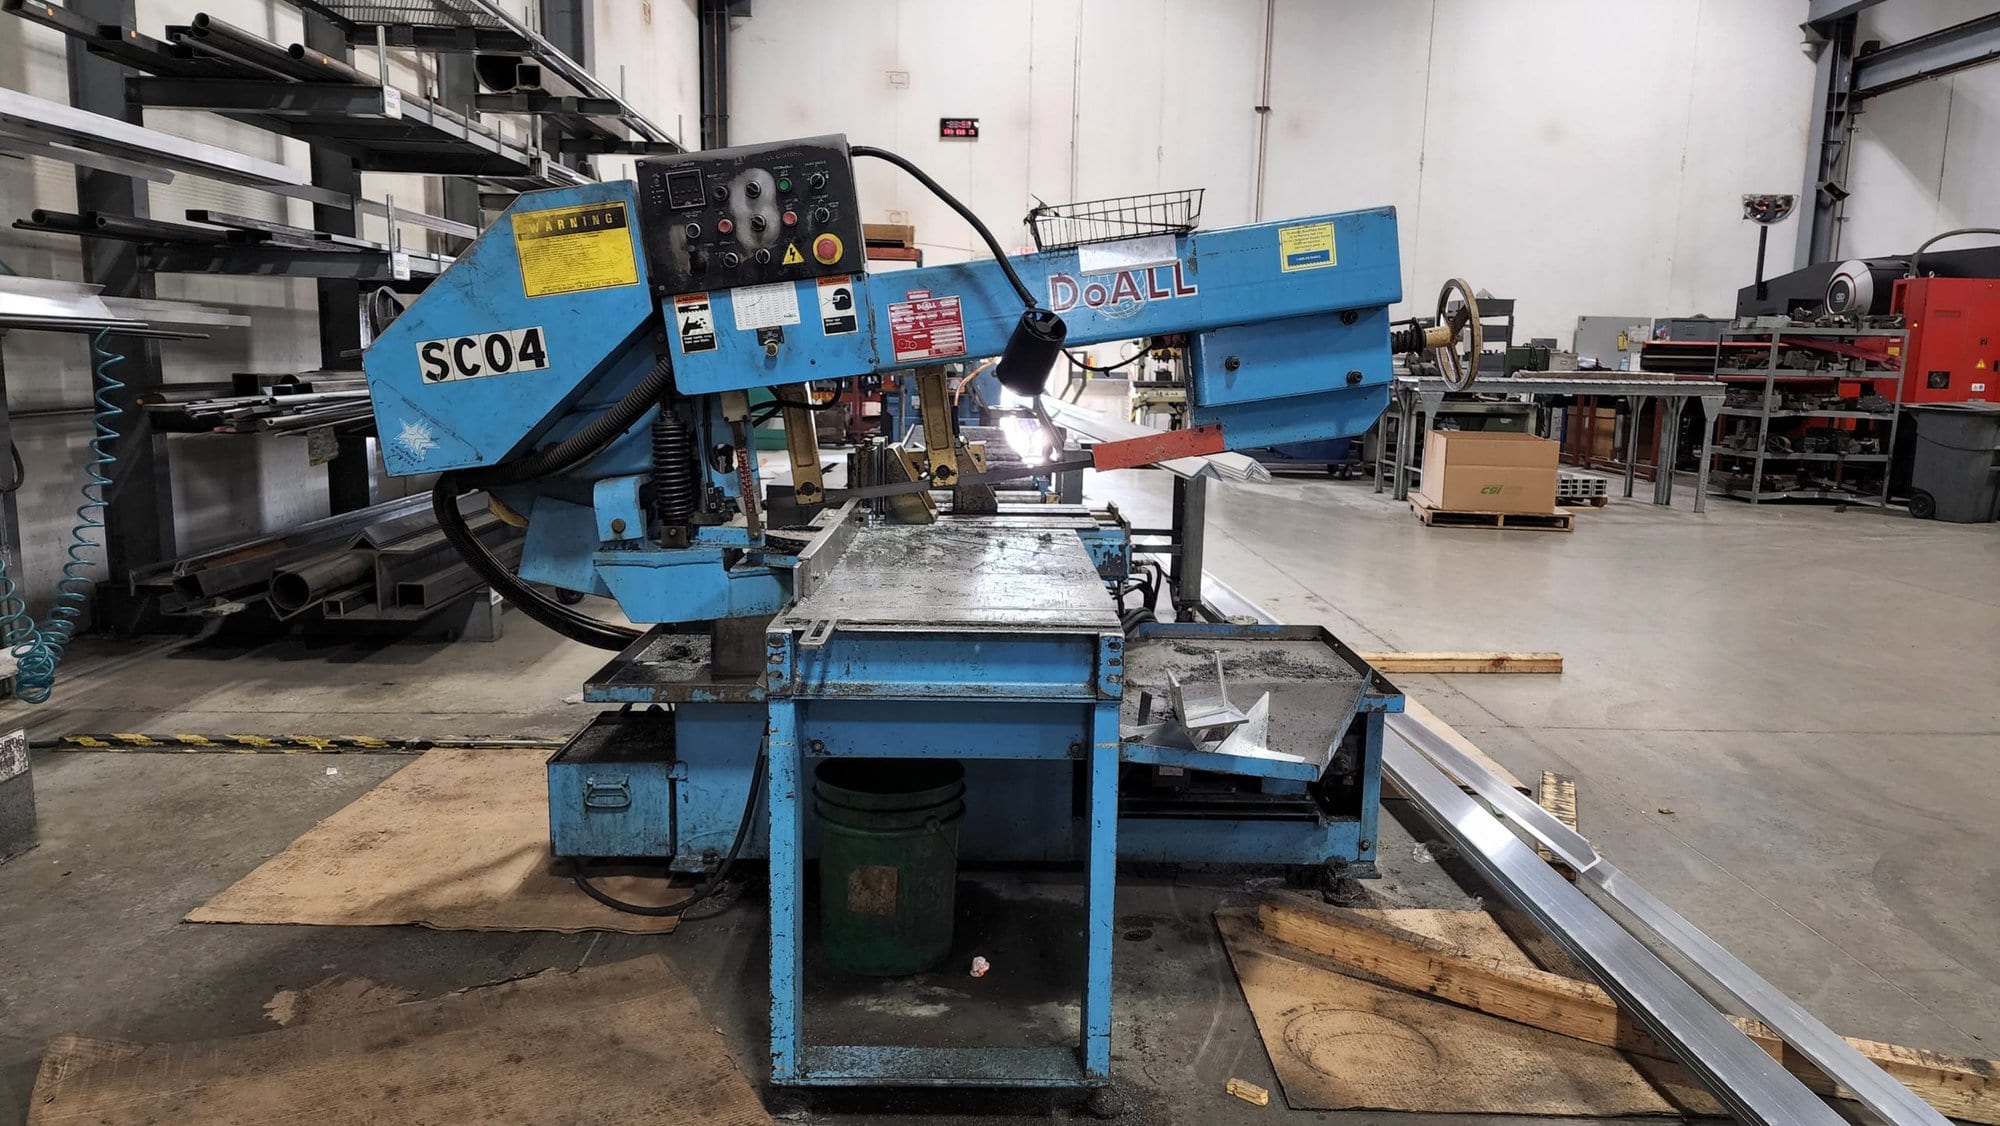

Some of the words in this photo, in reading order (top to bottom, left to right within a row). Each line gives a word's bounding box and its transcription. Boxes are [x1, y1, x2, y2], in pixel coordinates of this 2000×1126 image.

[529, 212, 614, 233] WARNING
[1049, 259, 1198, 313] DoALL
[421, 328, 546, 381] SC04
